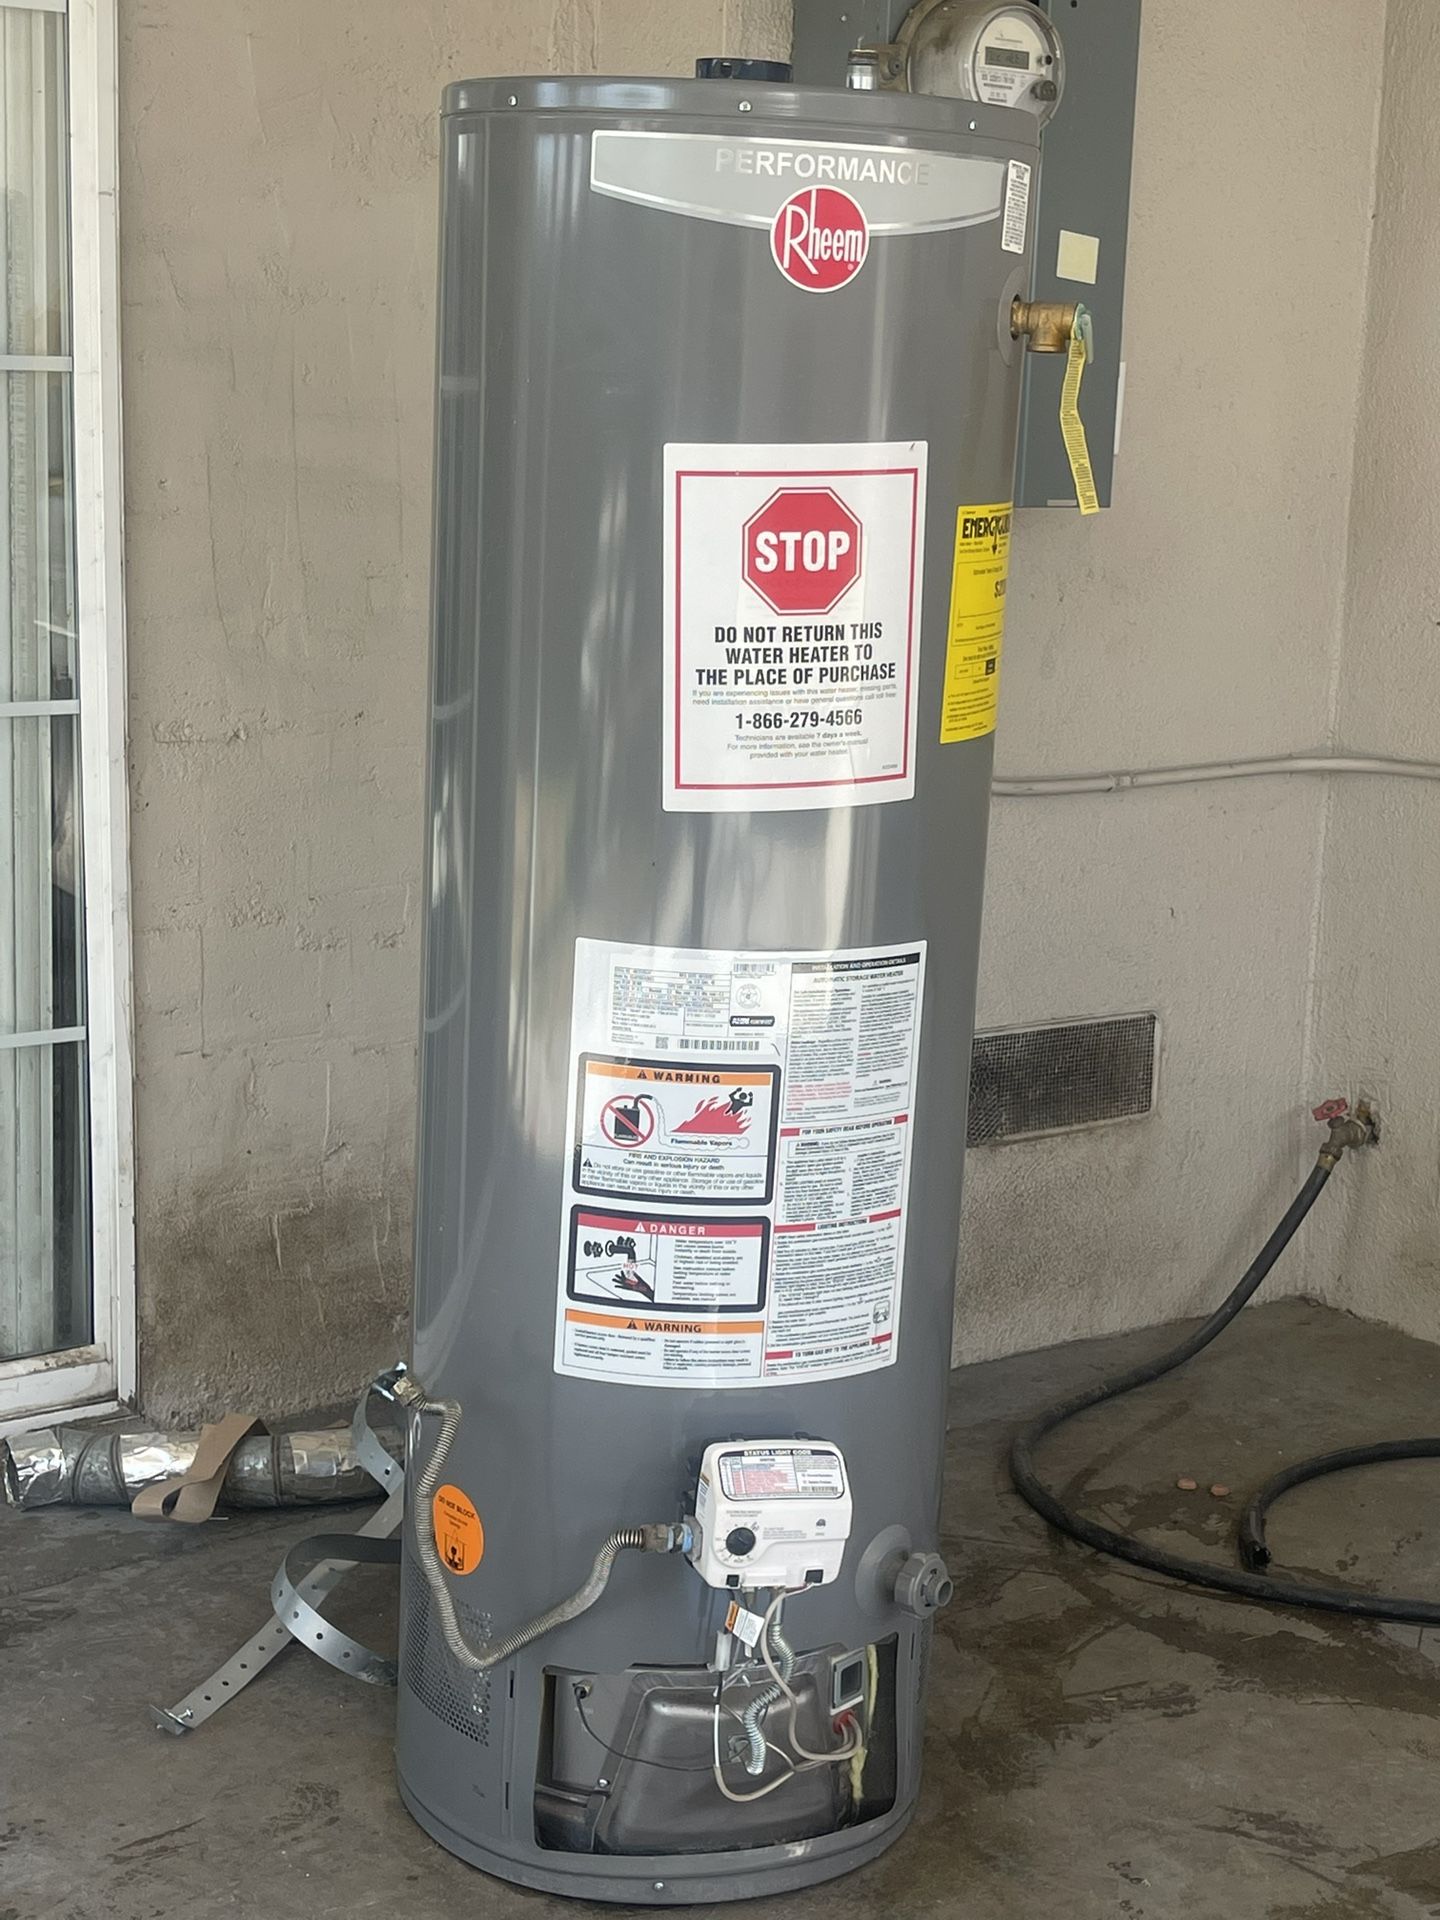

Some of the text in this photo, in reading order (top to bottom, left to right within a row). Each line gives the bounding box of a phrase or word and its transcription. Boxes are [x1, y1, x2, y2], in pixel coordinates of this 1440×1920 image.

[715, 148, 931, 186] PERFORMANCE
[783, 190, 863, 275] Rheem
[755, 530, 851, 573] STOP
[715, 622, 883, 643] DO NOT RETURN THIS
[726, 644, 873, 664] WATER HEATER TO
[696, 663, 896, 686] THE PLACE OF PURCHASE
[735, 709, 863, 729] 1-866-279-4566
[822, 732, 838, 740] days
[749, 752, 778, 760] provided
[654, 1071, 721, 1084] WARNING
[671, 1138, 708, 1146] Flammable
[650, 1224, 706, 1235] DANGER
[623, 1262, 639, 1270] HOT
[644, 1322, 702, 1333] WARNING
